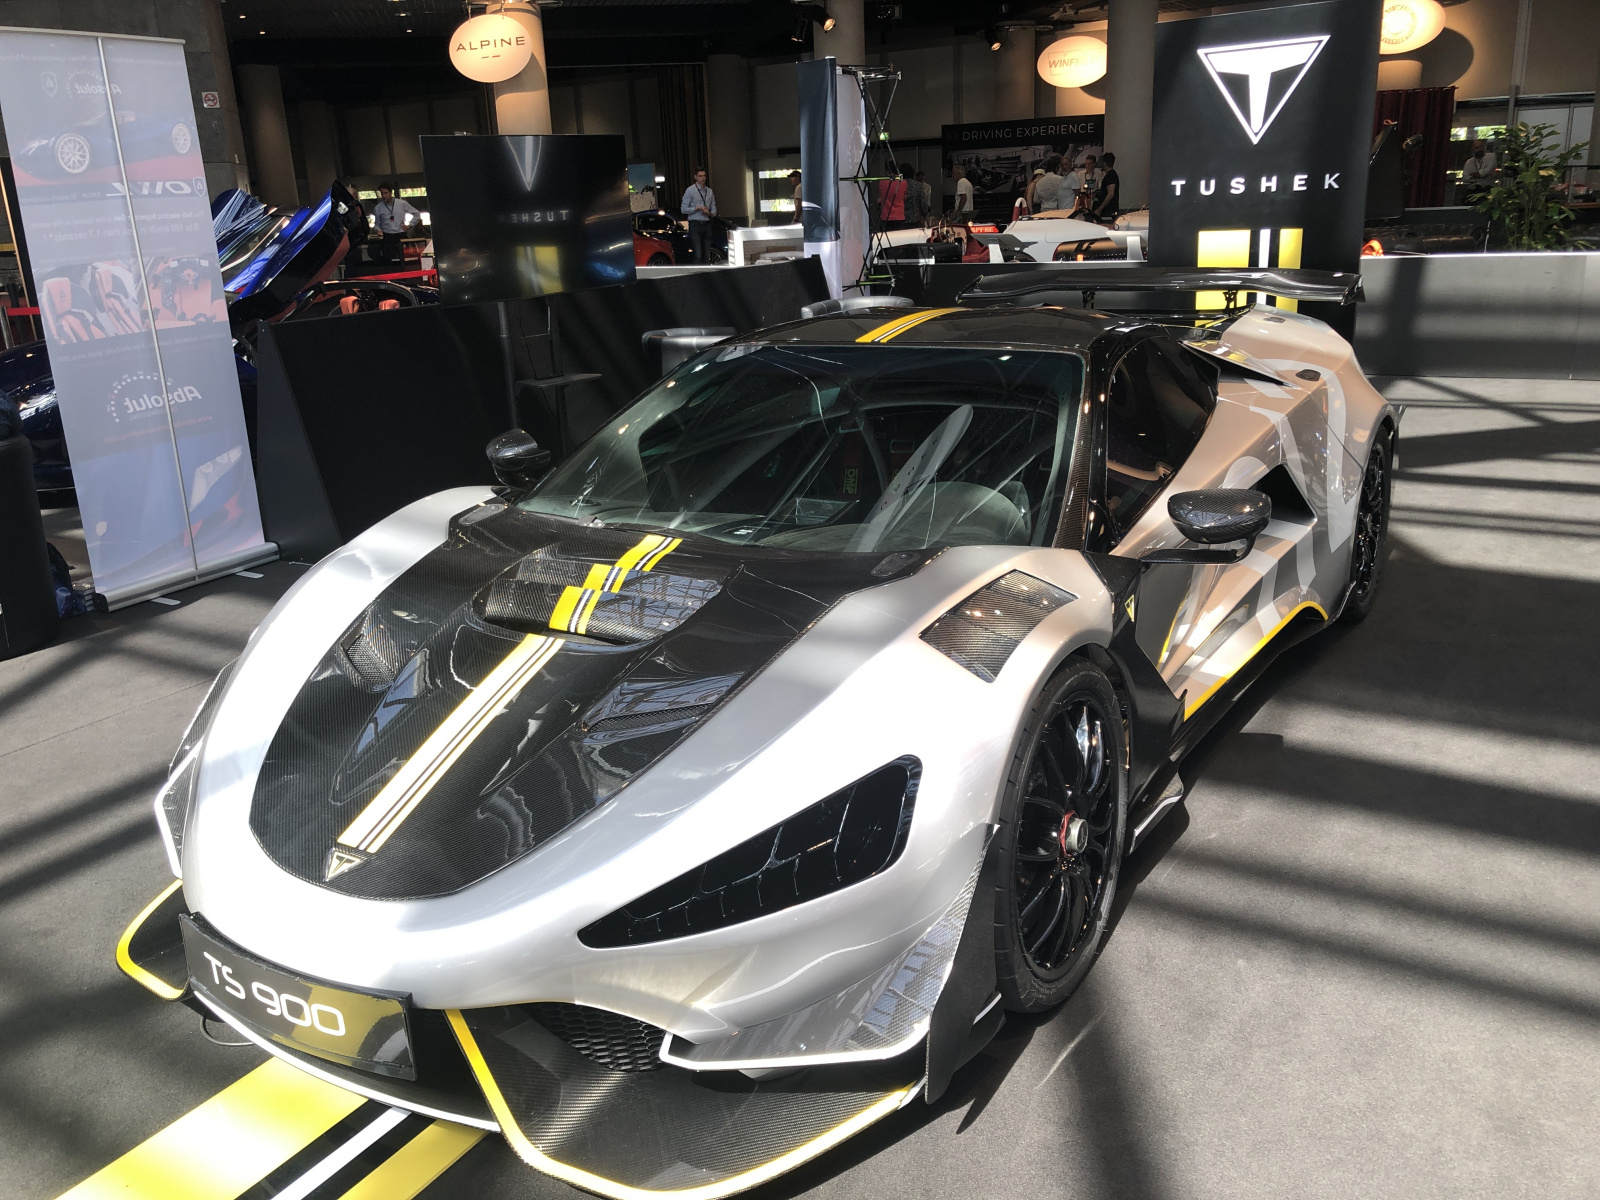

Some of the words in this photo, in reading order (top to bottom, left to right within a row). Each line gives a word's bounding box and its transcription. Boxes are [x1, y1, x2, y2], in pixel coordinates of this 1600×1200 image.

[456, 35, 526, 53] ALPINE
[1049, 55, 1098, 69] WINFI
[962, 128, 1012, 141] DRIVING
[1016, 122, 1095, 138] EXPERIENCE
[1170, 172, 1341, 197] TUSHEK
[970, 226, 994, 234] APFRE
[844, 468, 857, 494] OMP
[203, 951, 246, 1000] TS
[251, 981, 346, 1037] 900
